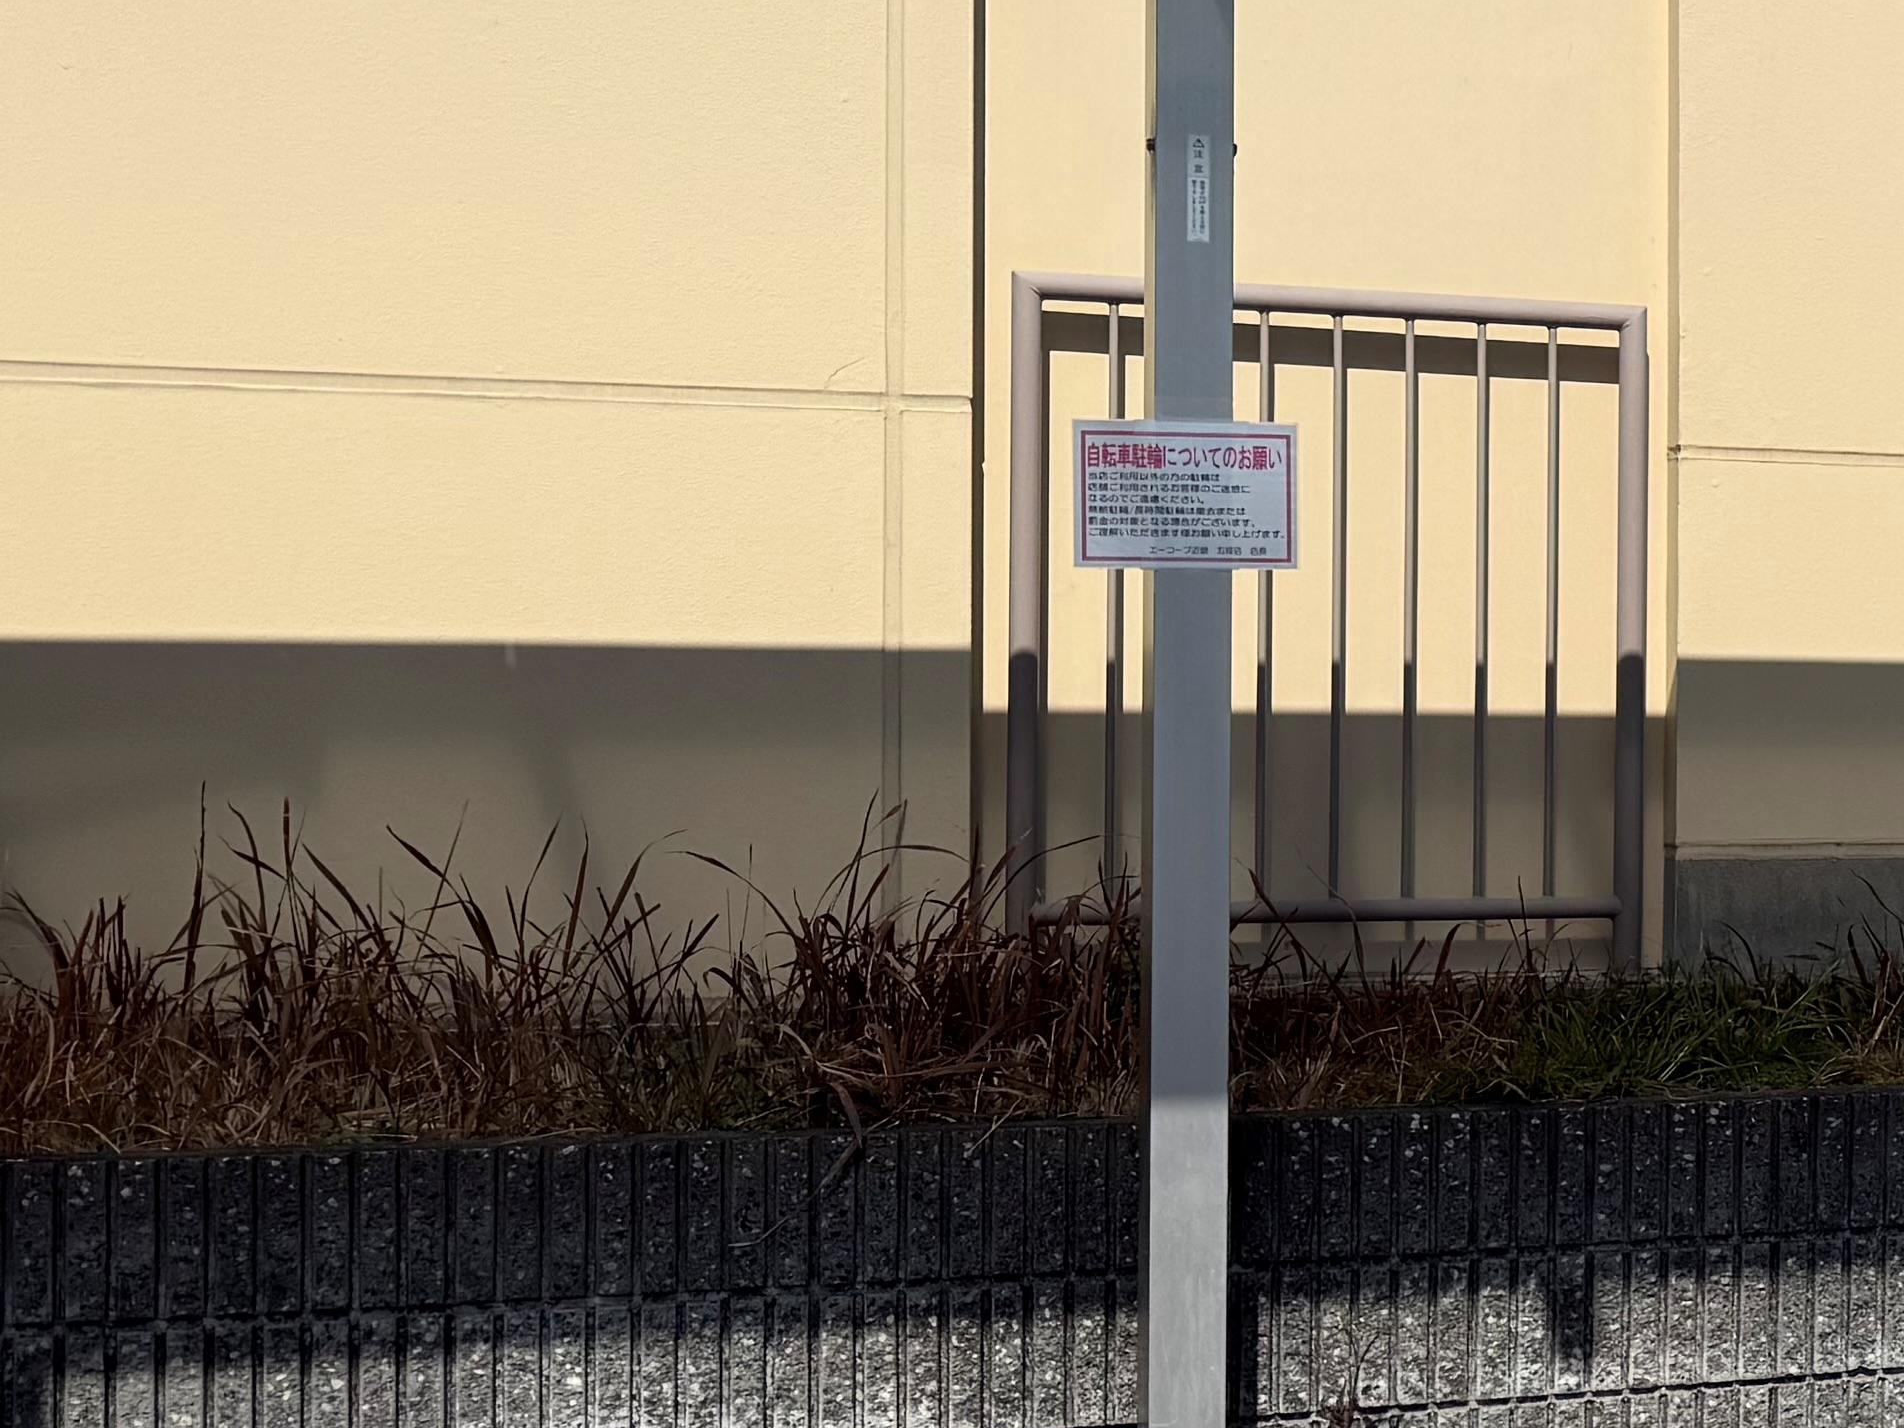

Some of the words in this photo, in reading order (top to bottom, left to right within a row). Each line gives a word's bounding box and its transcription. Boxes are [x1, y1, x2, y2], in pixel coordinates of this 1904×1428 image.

[1087, 442, 1282, 470] 自転車駐輪についてのお願い
